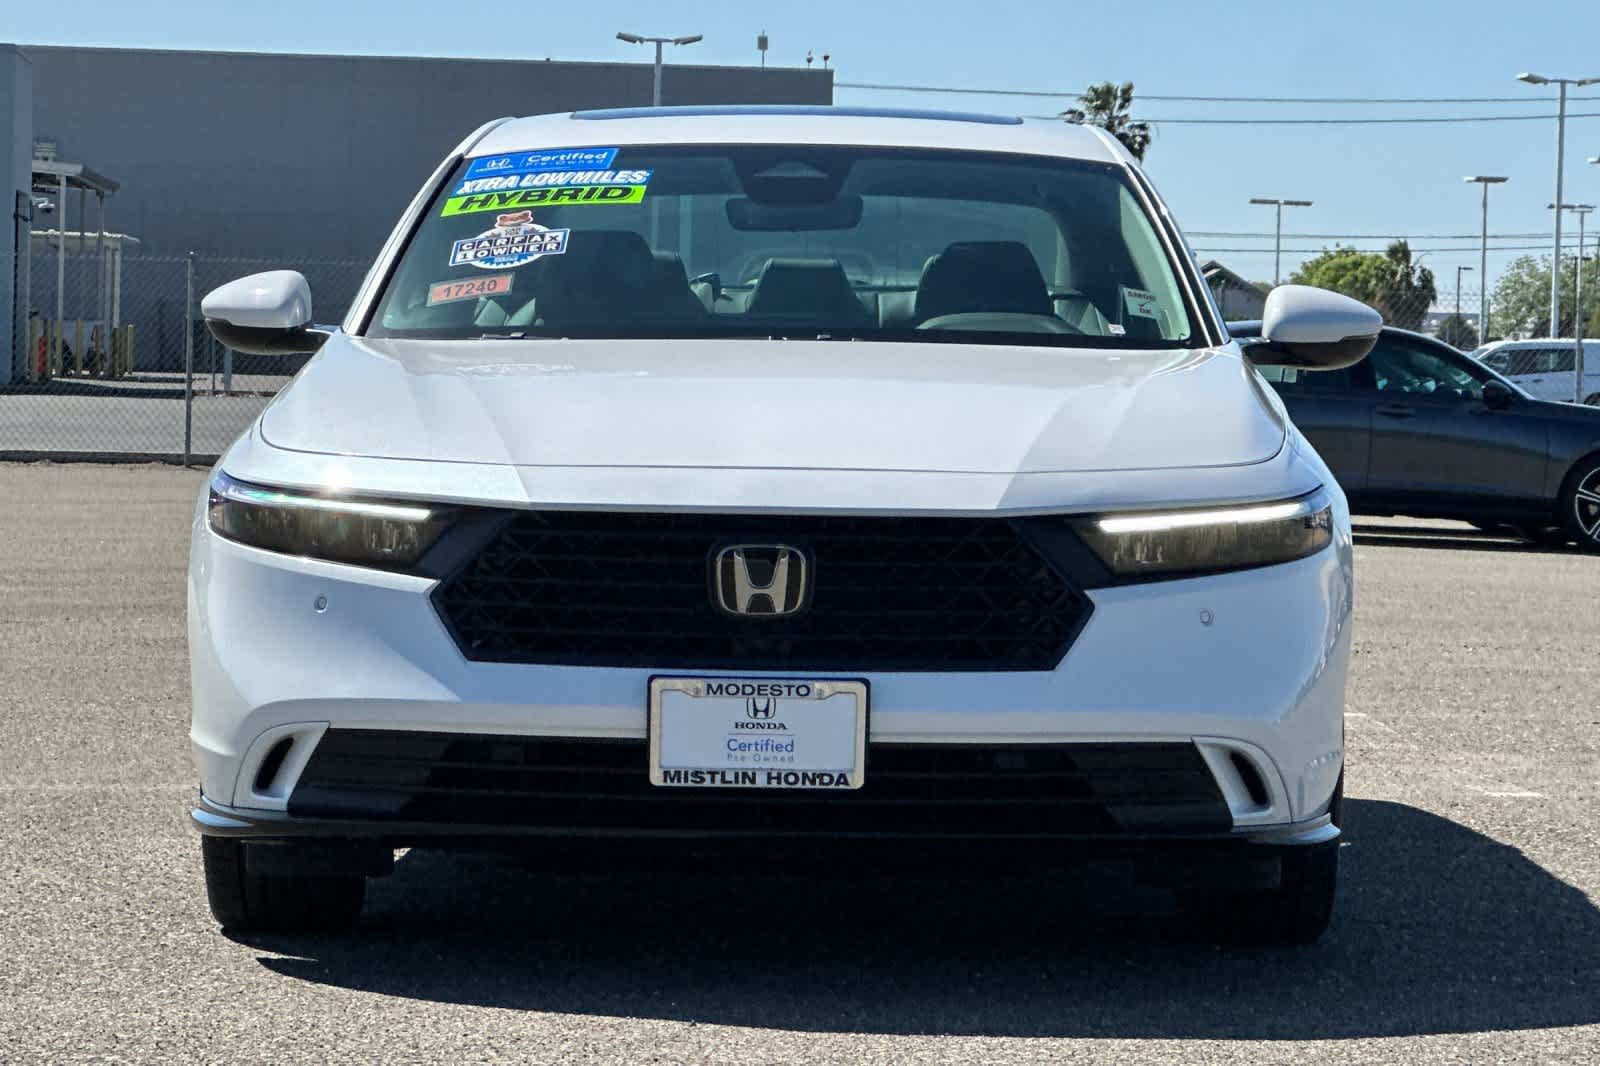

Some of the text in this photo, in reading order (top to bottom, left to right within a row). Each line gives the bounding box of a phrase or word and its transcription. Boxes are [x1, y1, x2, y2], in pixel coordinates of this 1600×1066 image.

[528, 151, 608, 163] Certified
[457, 175, 520, 194] XTRA
[459, 187, 634, 211] HYBRID
[461, 234, 560, 250] CARFAX
[476, 243, 558, 258] OWNER
[443, 279, 498, 297] 17240
[706, 683, 811, 697] MODESTO
[734, 721, 788, 731] HONDA
[727, 738, 795, 753] Certified
[662, 769, 850, 787] MISTLIN HONDA
